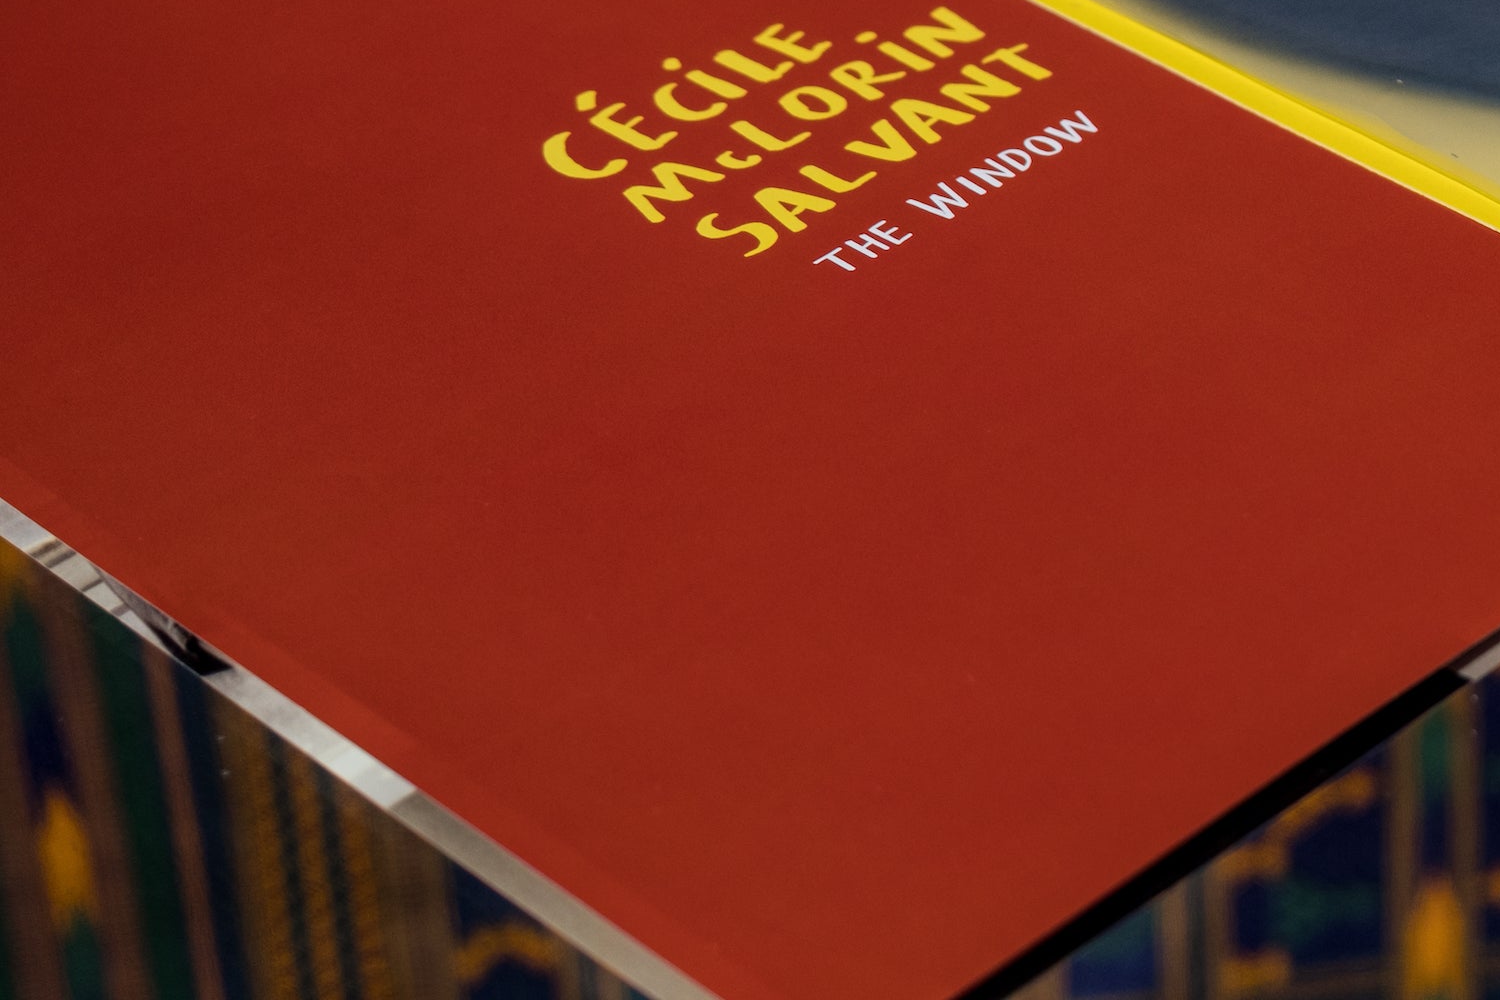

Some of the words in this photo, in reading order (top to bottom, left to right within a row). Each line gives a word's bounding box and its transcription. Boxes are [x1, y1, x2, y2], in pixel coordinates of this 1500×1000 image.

[695, 42, 1053, 258] SALVANT
[812, 218, 914, 272] THE
[905, 109, 1100, 220] WINDOW
